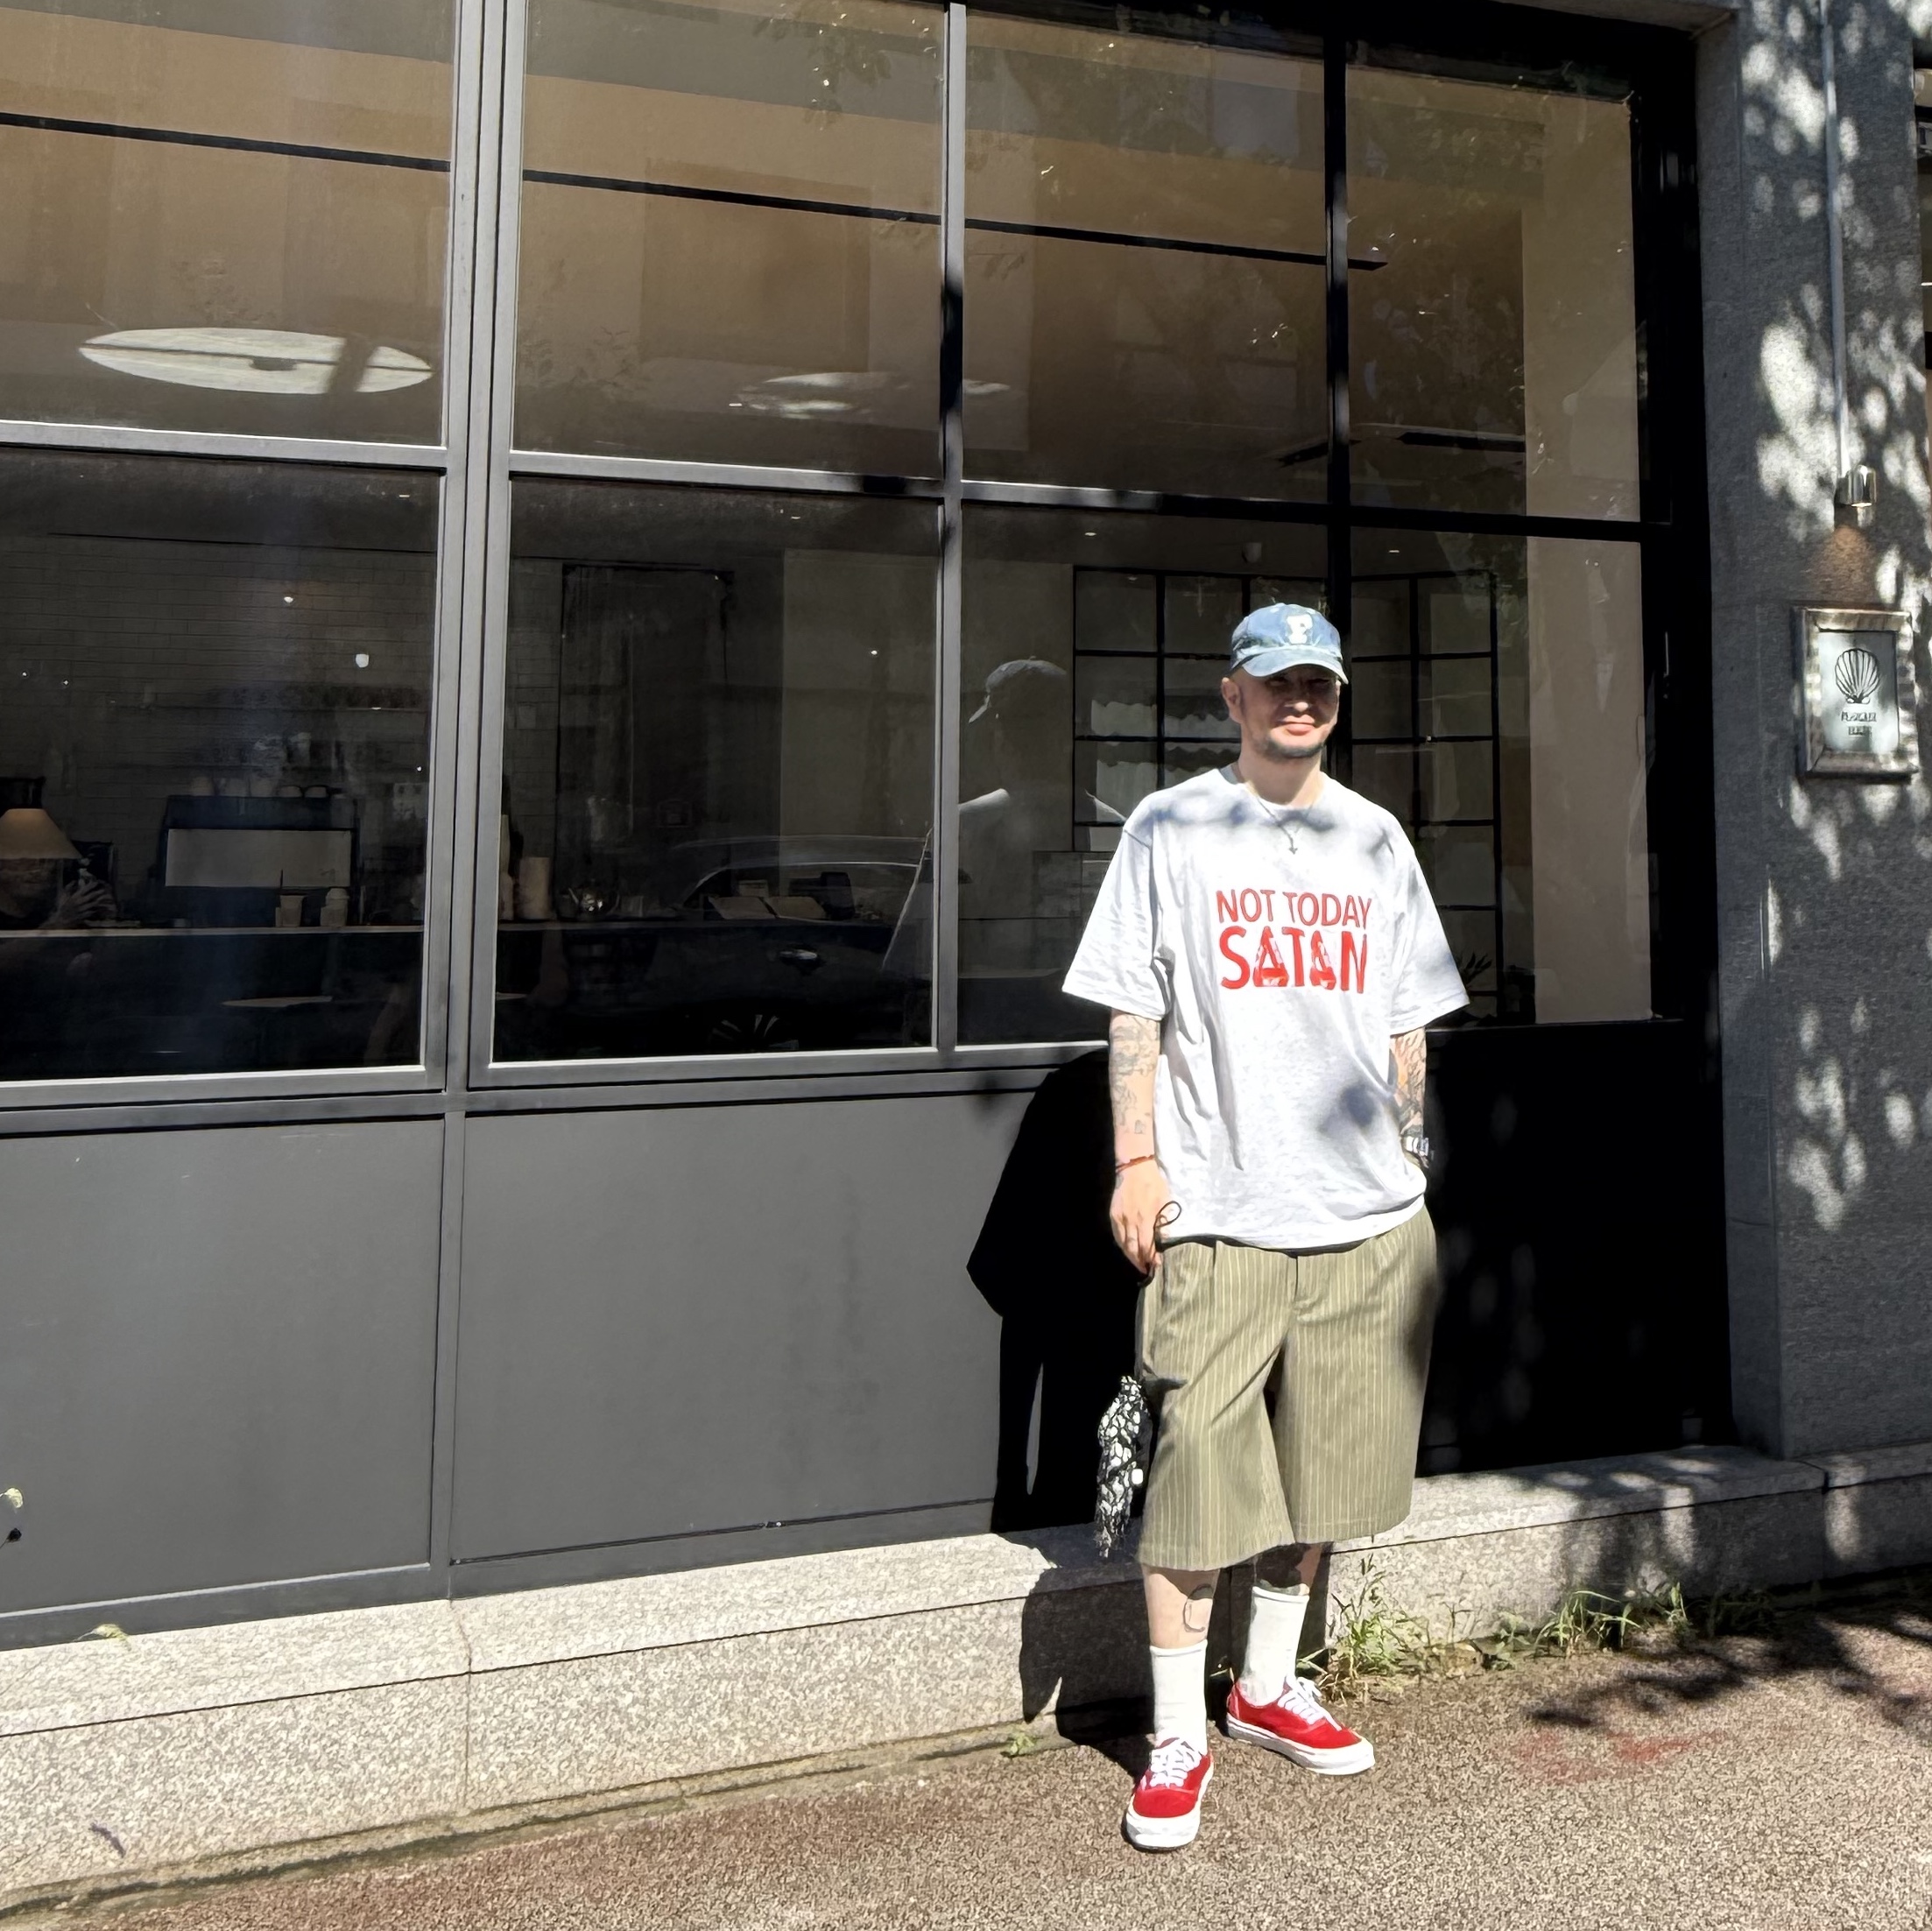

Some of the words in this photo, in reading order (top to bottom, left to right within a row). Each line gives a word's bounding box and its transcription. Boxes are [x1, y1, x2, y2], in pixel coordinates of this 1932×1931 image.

[1216, 888, 1275, 923] NOT
[1282, 892, 1372, 930] TODAY
[1219, 926, 1367, 994] SATAN
